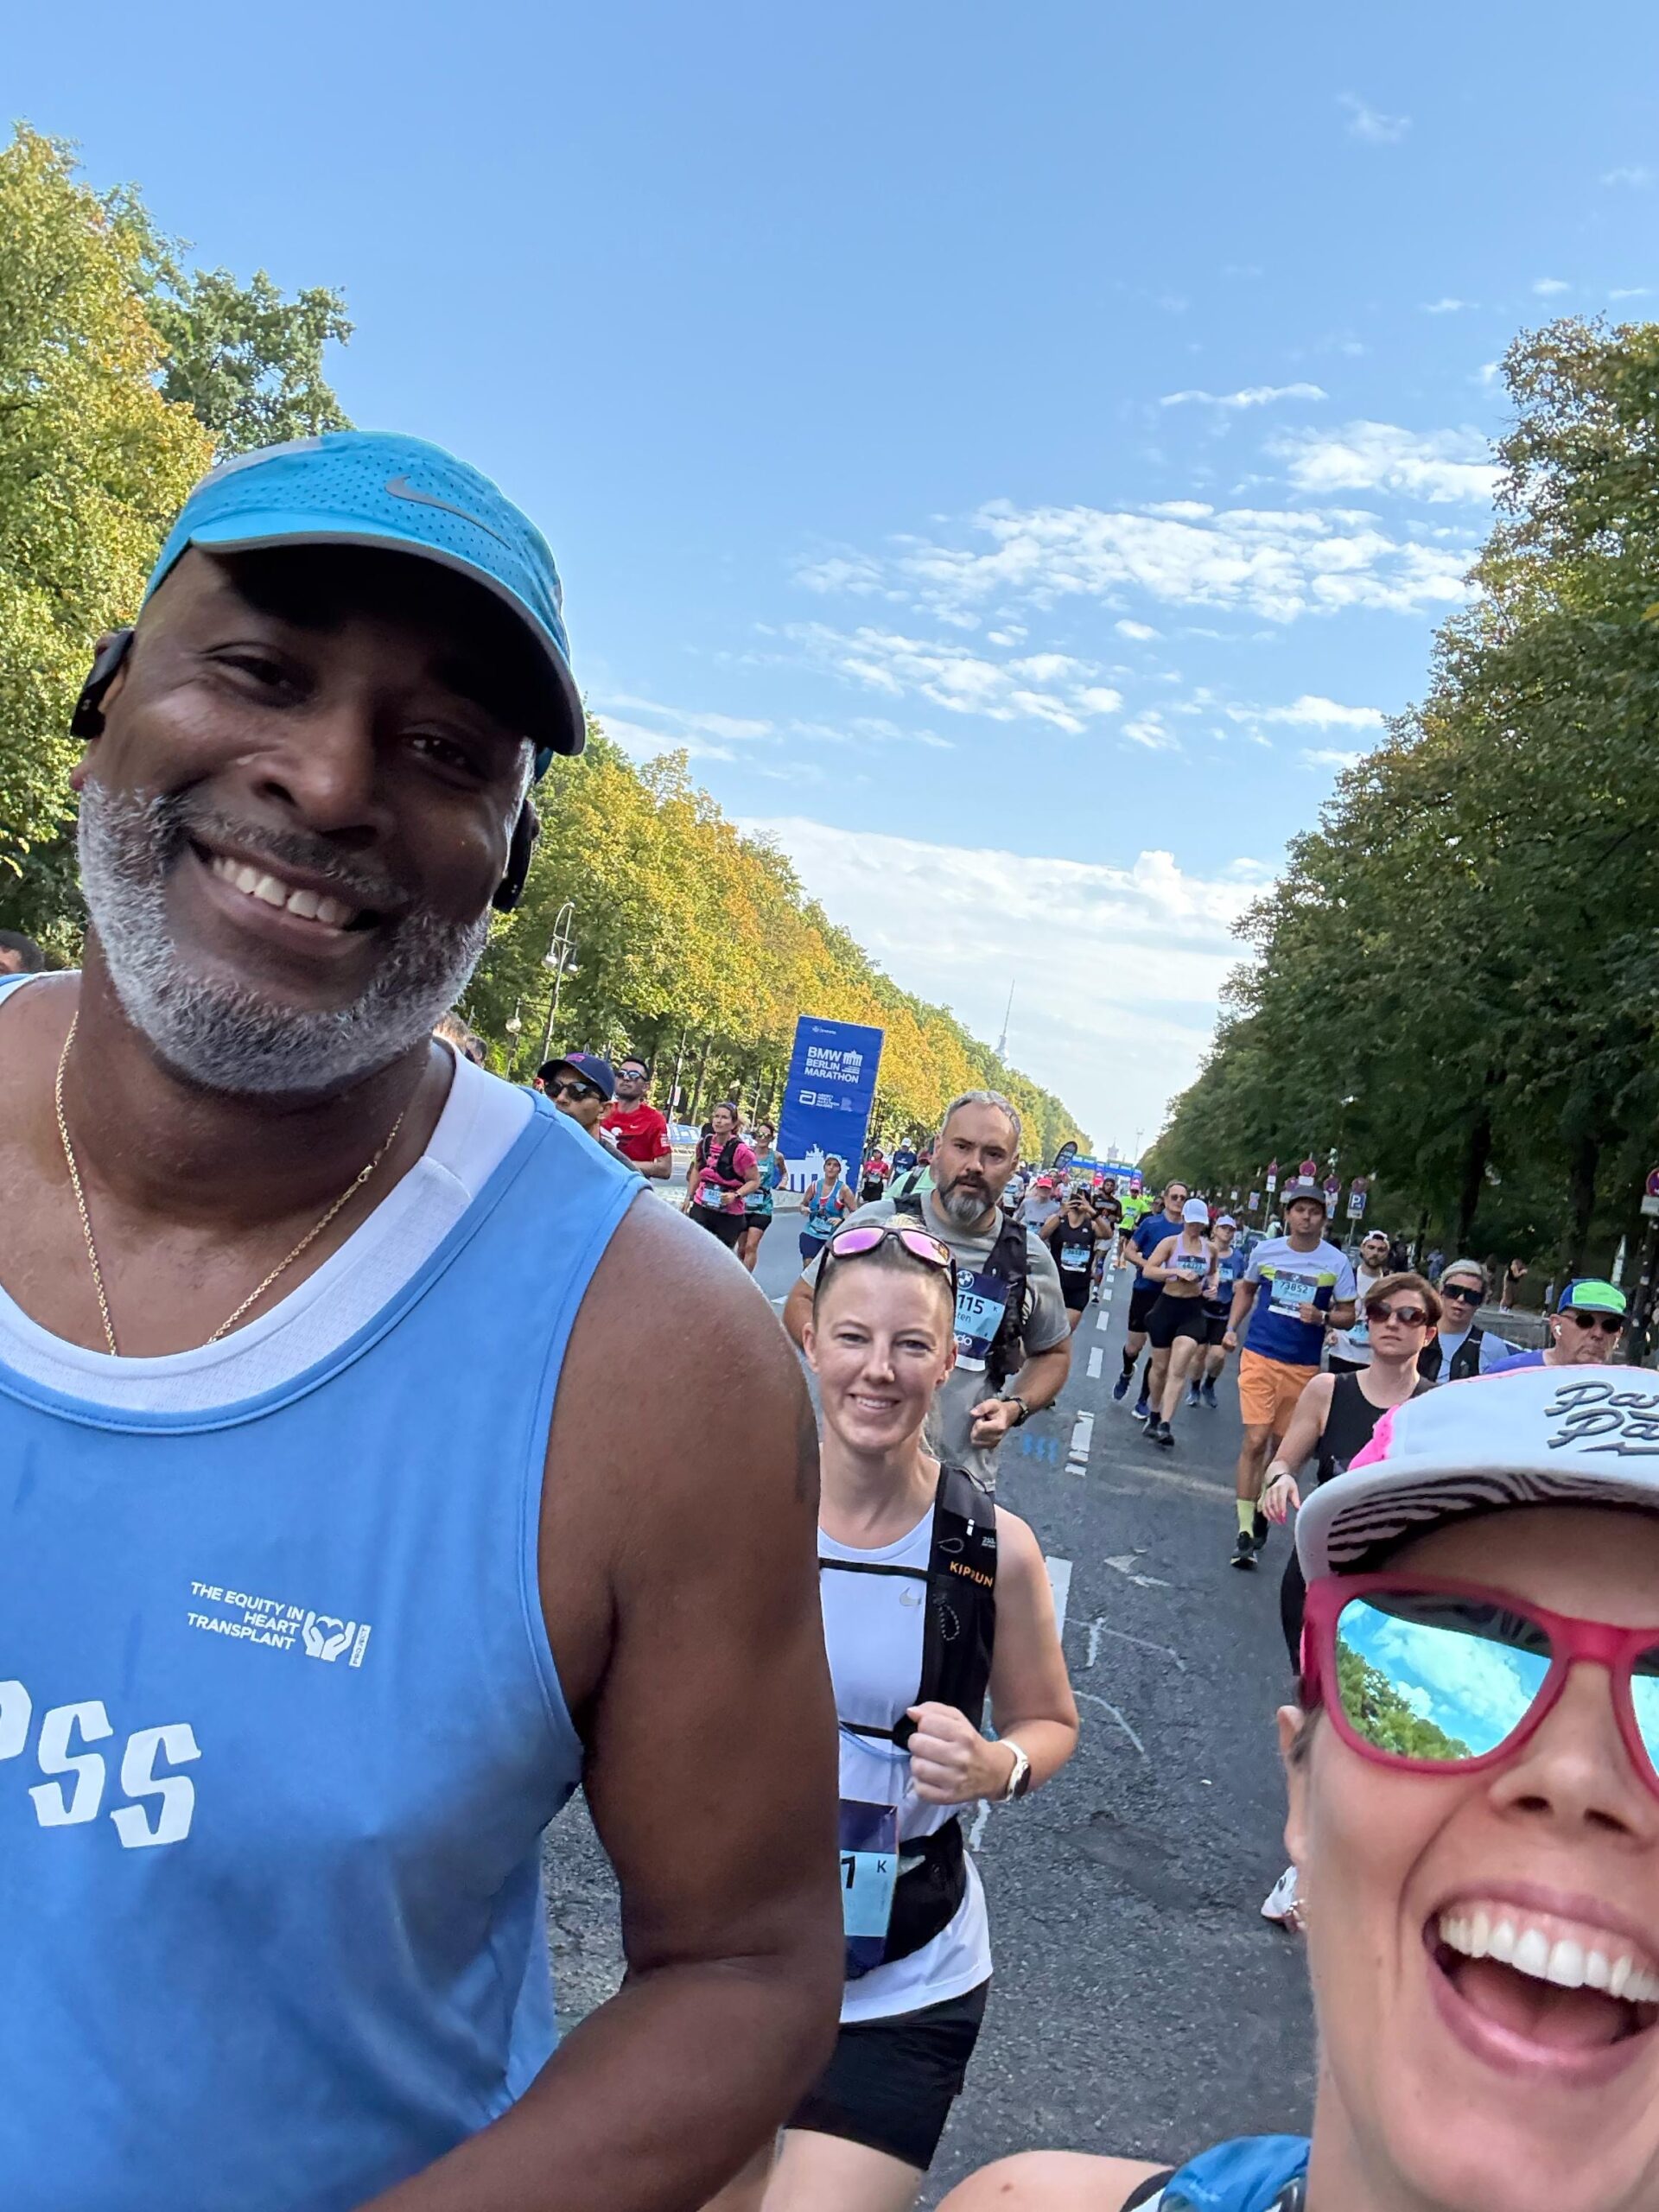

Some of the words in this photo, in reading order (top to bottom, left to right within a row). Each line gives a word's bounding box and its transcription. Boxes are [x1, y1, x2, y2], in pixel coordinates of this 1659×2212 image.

[807, 1046, 842, 1062] BMW
[805, 1058, 841, 1071] BERLIN
[804, 1066, 860, 1084] MARATHON
[957, 1294, 985, 1315] 115
[191, 1581, 224, 1601] THE
[224, 1590, 286, 1616] EQUITY
[286, 1605, 305, 1621] IN
[188, 1612, 296, 1650] TRANSPLANT
[243, 1611, 301, 1635] HEART
[876, 1859, 887, 1873] K
